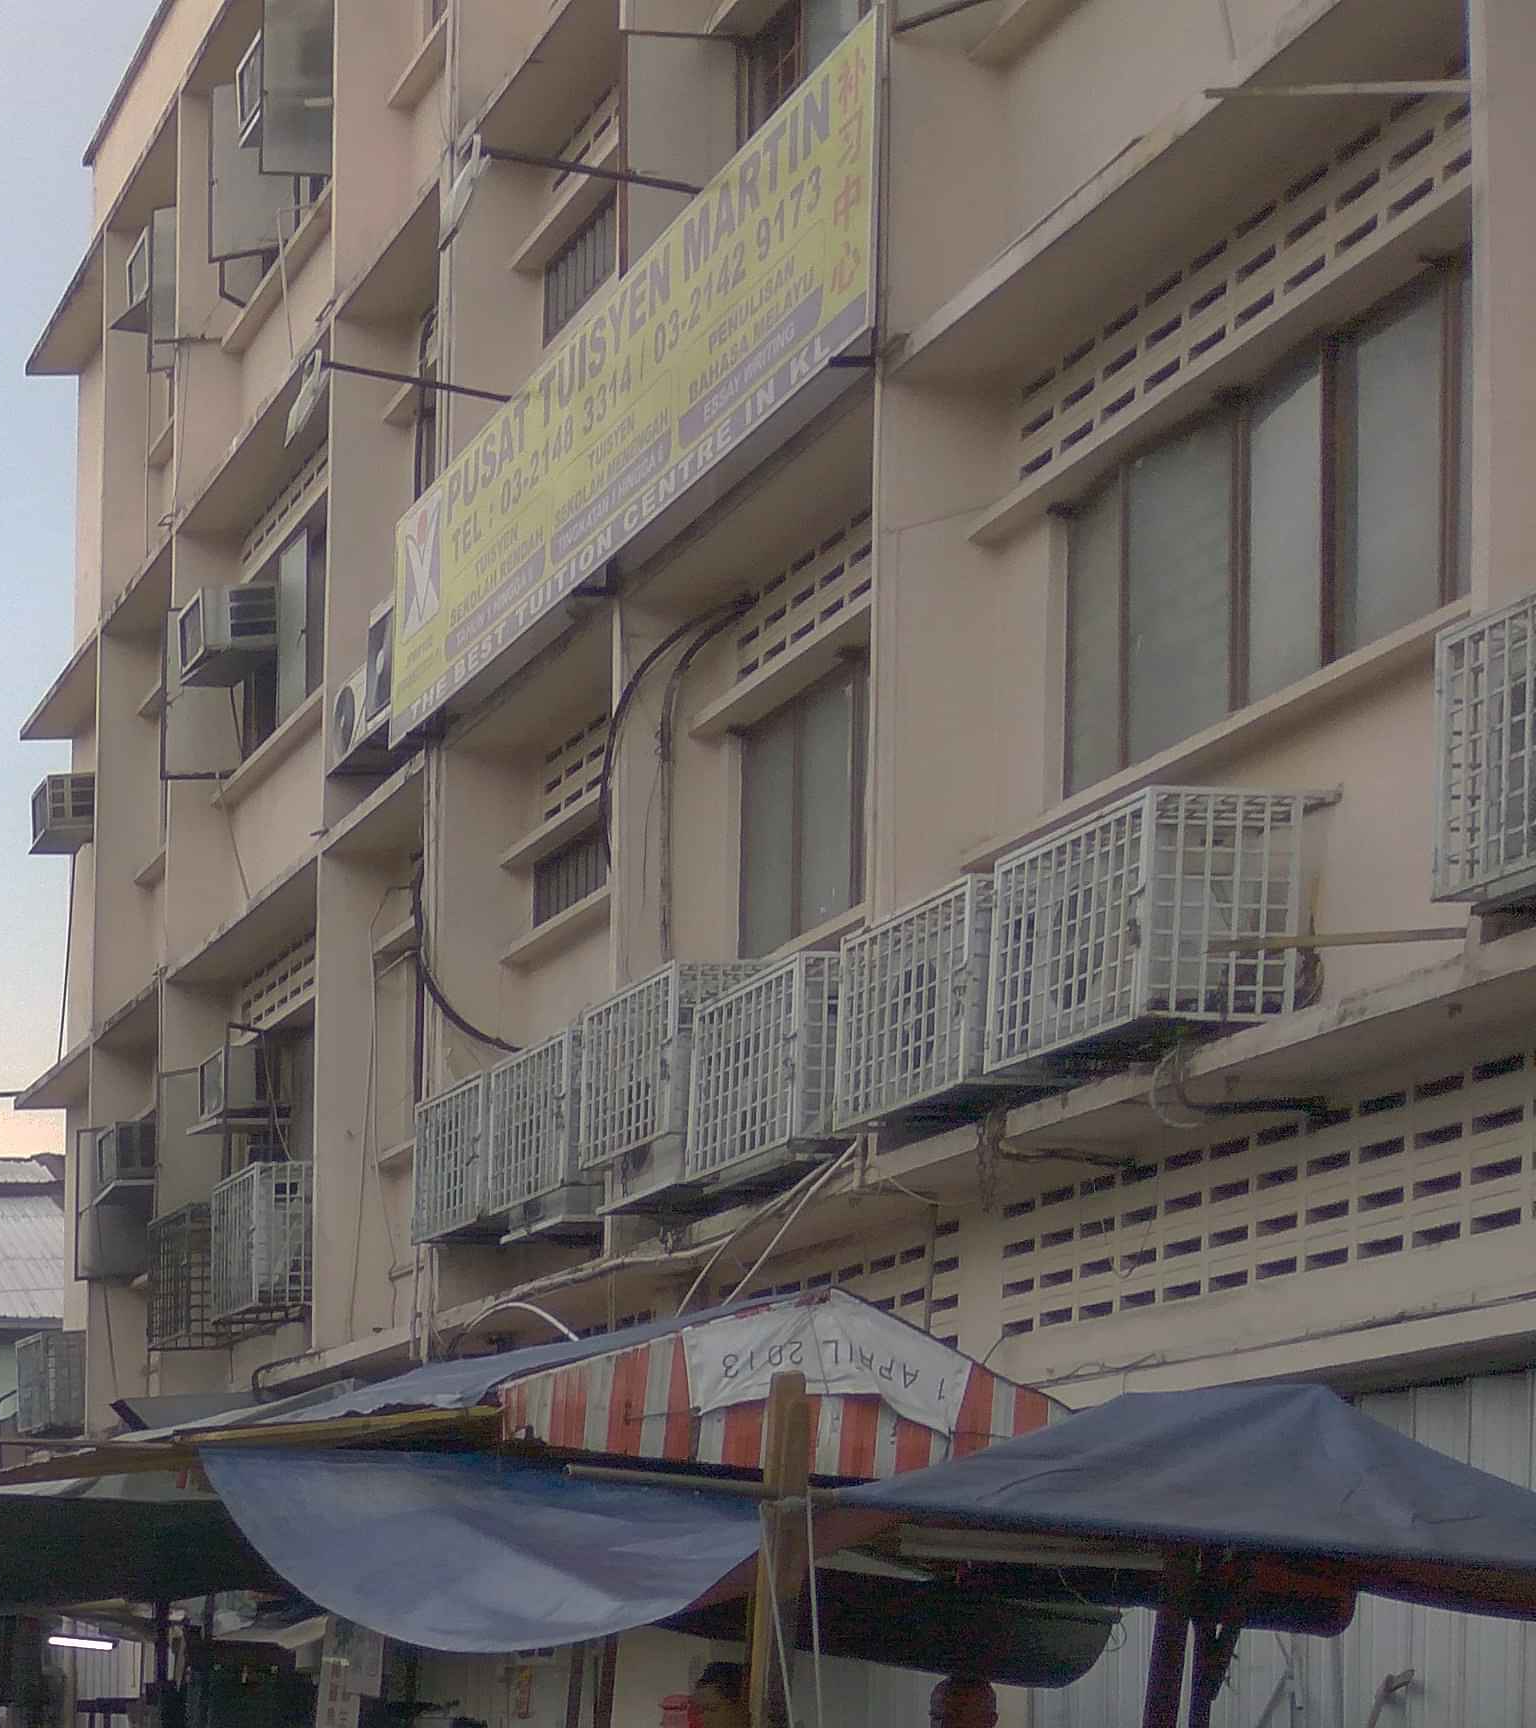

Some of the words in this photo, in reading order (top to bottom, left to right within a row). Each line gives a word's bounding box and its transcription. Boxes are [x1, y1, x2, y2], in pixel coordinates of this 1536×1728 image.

[447, 390, 528, 526] PUSAT
[538, 239, 671, 433] TUISYEN
[681, 67, 832, 287] MARTIN
[707, 252, 794, 359] PENULISAN
[452, 503, 481, 565] TEL
[500, 410, 573, 519] 03-2148
[582, 350, 632, 438] 3314
[654, 235, 746, 368] 03-2142
[755, 158, 821, 268] 9173
[688, 327, 749, 407] BAHASA
[410, 672, 447, 724] THE
[453, 618, 506, 686] BEST
[514, 523, 612, 632] TUITION
[622, 414, 733, 536] CENTRE
[742, 375, 775, 431] IN
[790, 324, 830, 387] KL
[722, 1341, 804, 1378] 2013
[823, 1339, 920, 1389] APRIL
